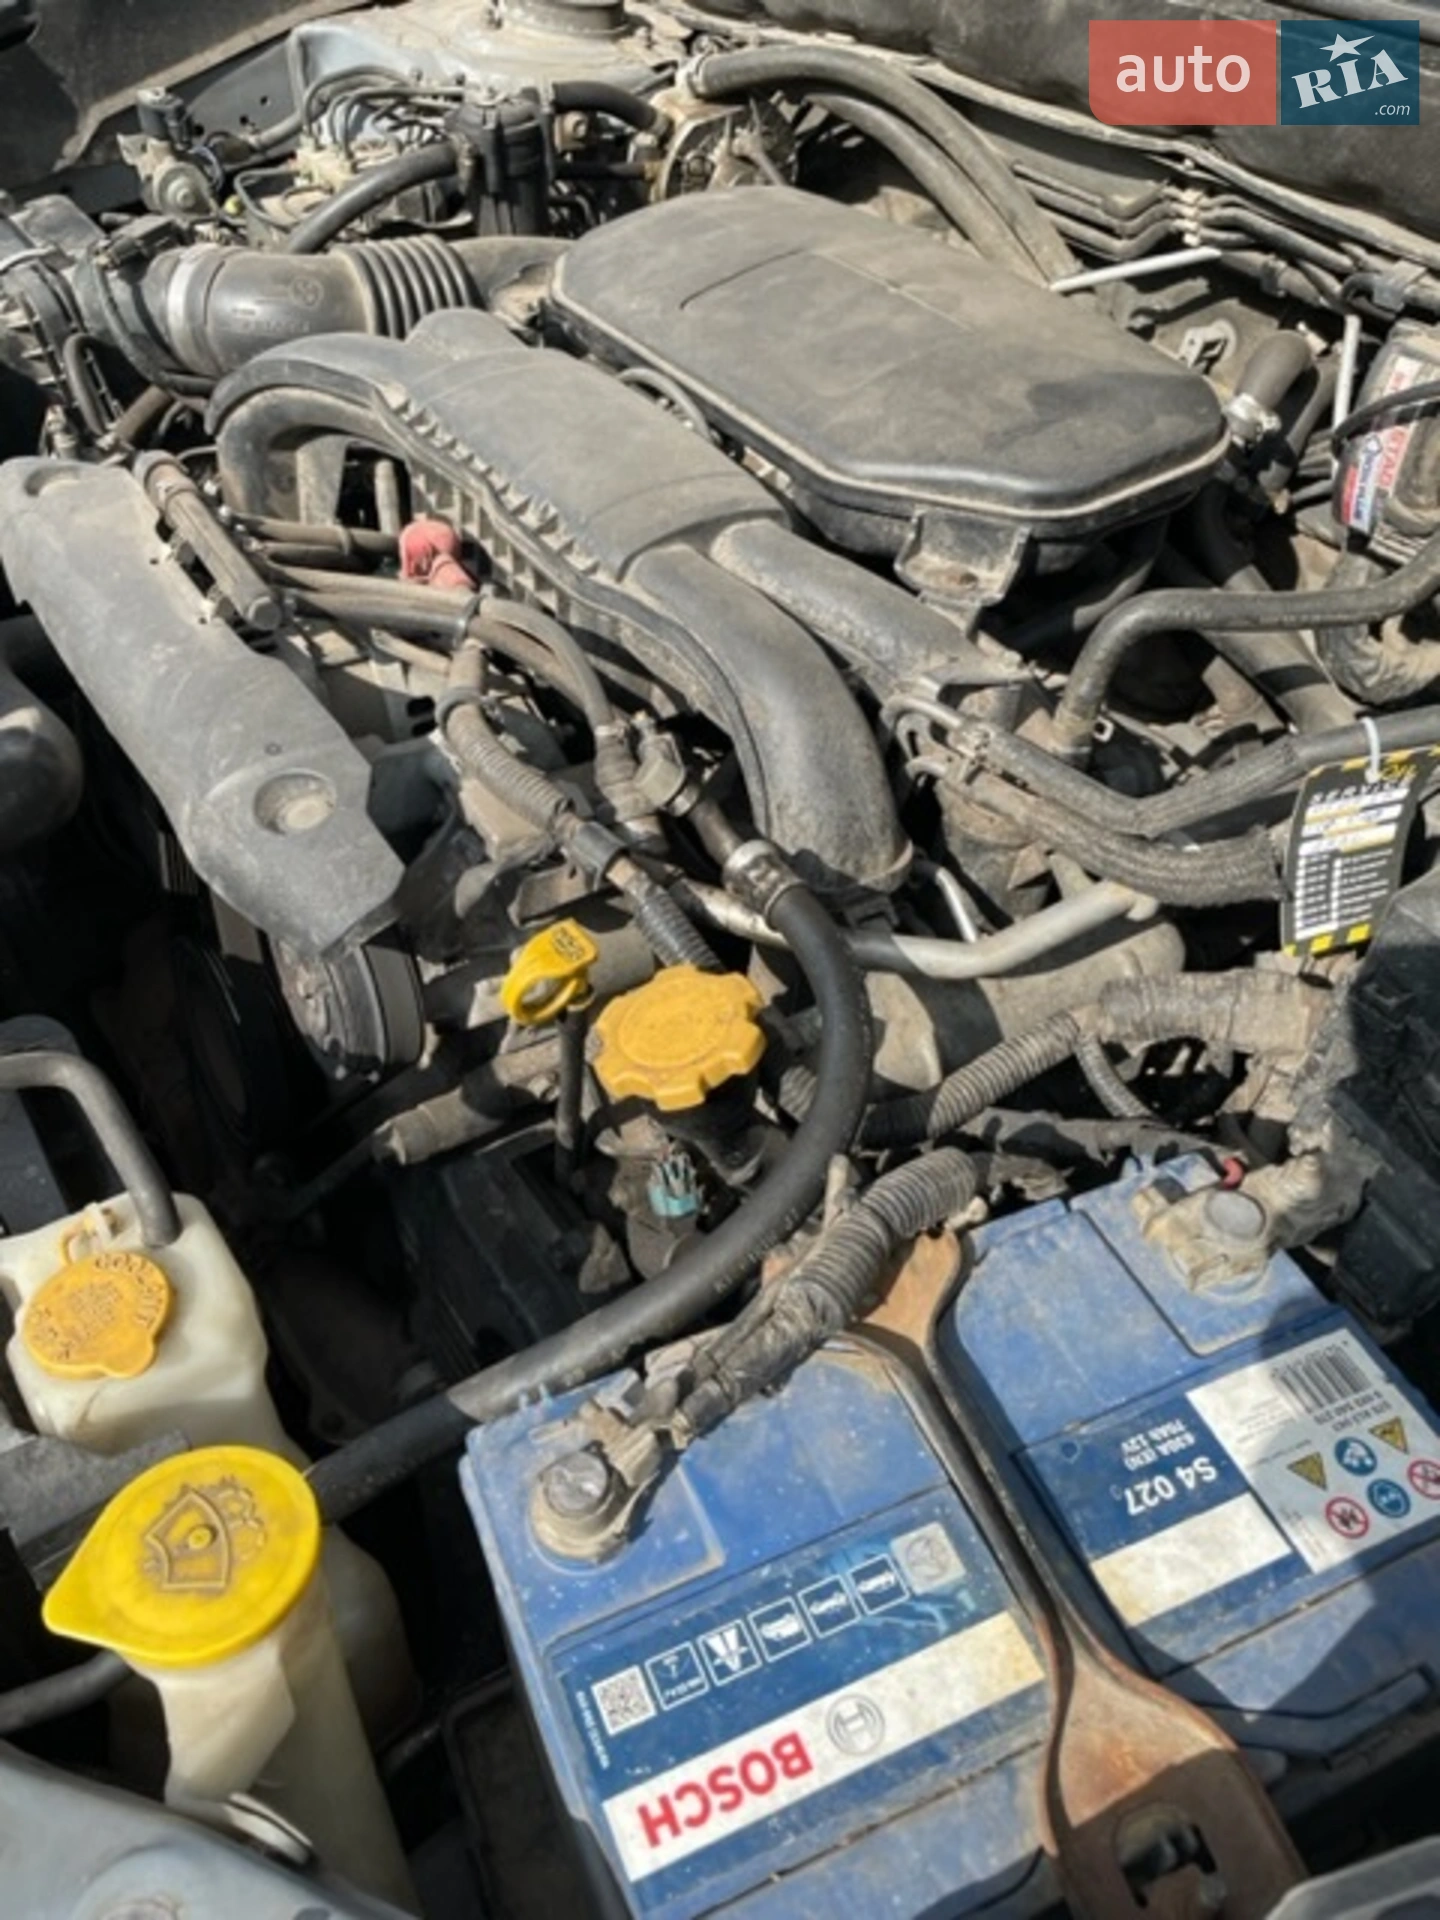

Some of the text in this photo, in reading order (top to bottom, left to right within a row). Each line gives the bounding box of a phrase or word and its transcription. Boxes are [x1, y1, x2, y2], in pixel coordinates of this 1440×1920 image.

[1123, 1456, 1218, 1516] S4 027
[637, 1730, 813, 1849] BOSCH
